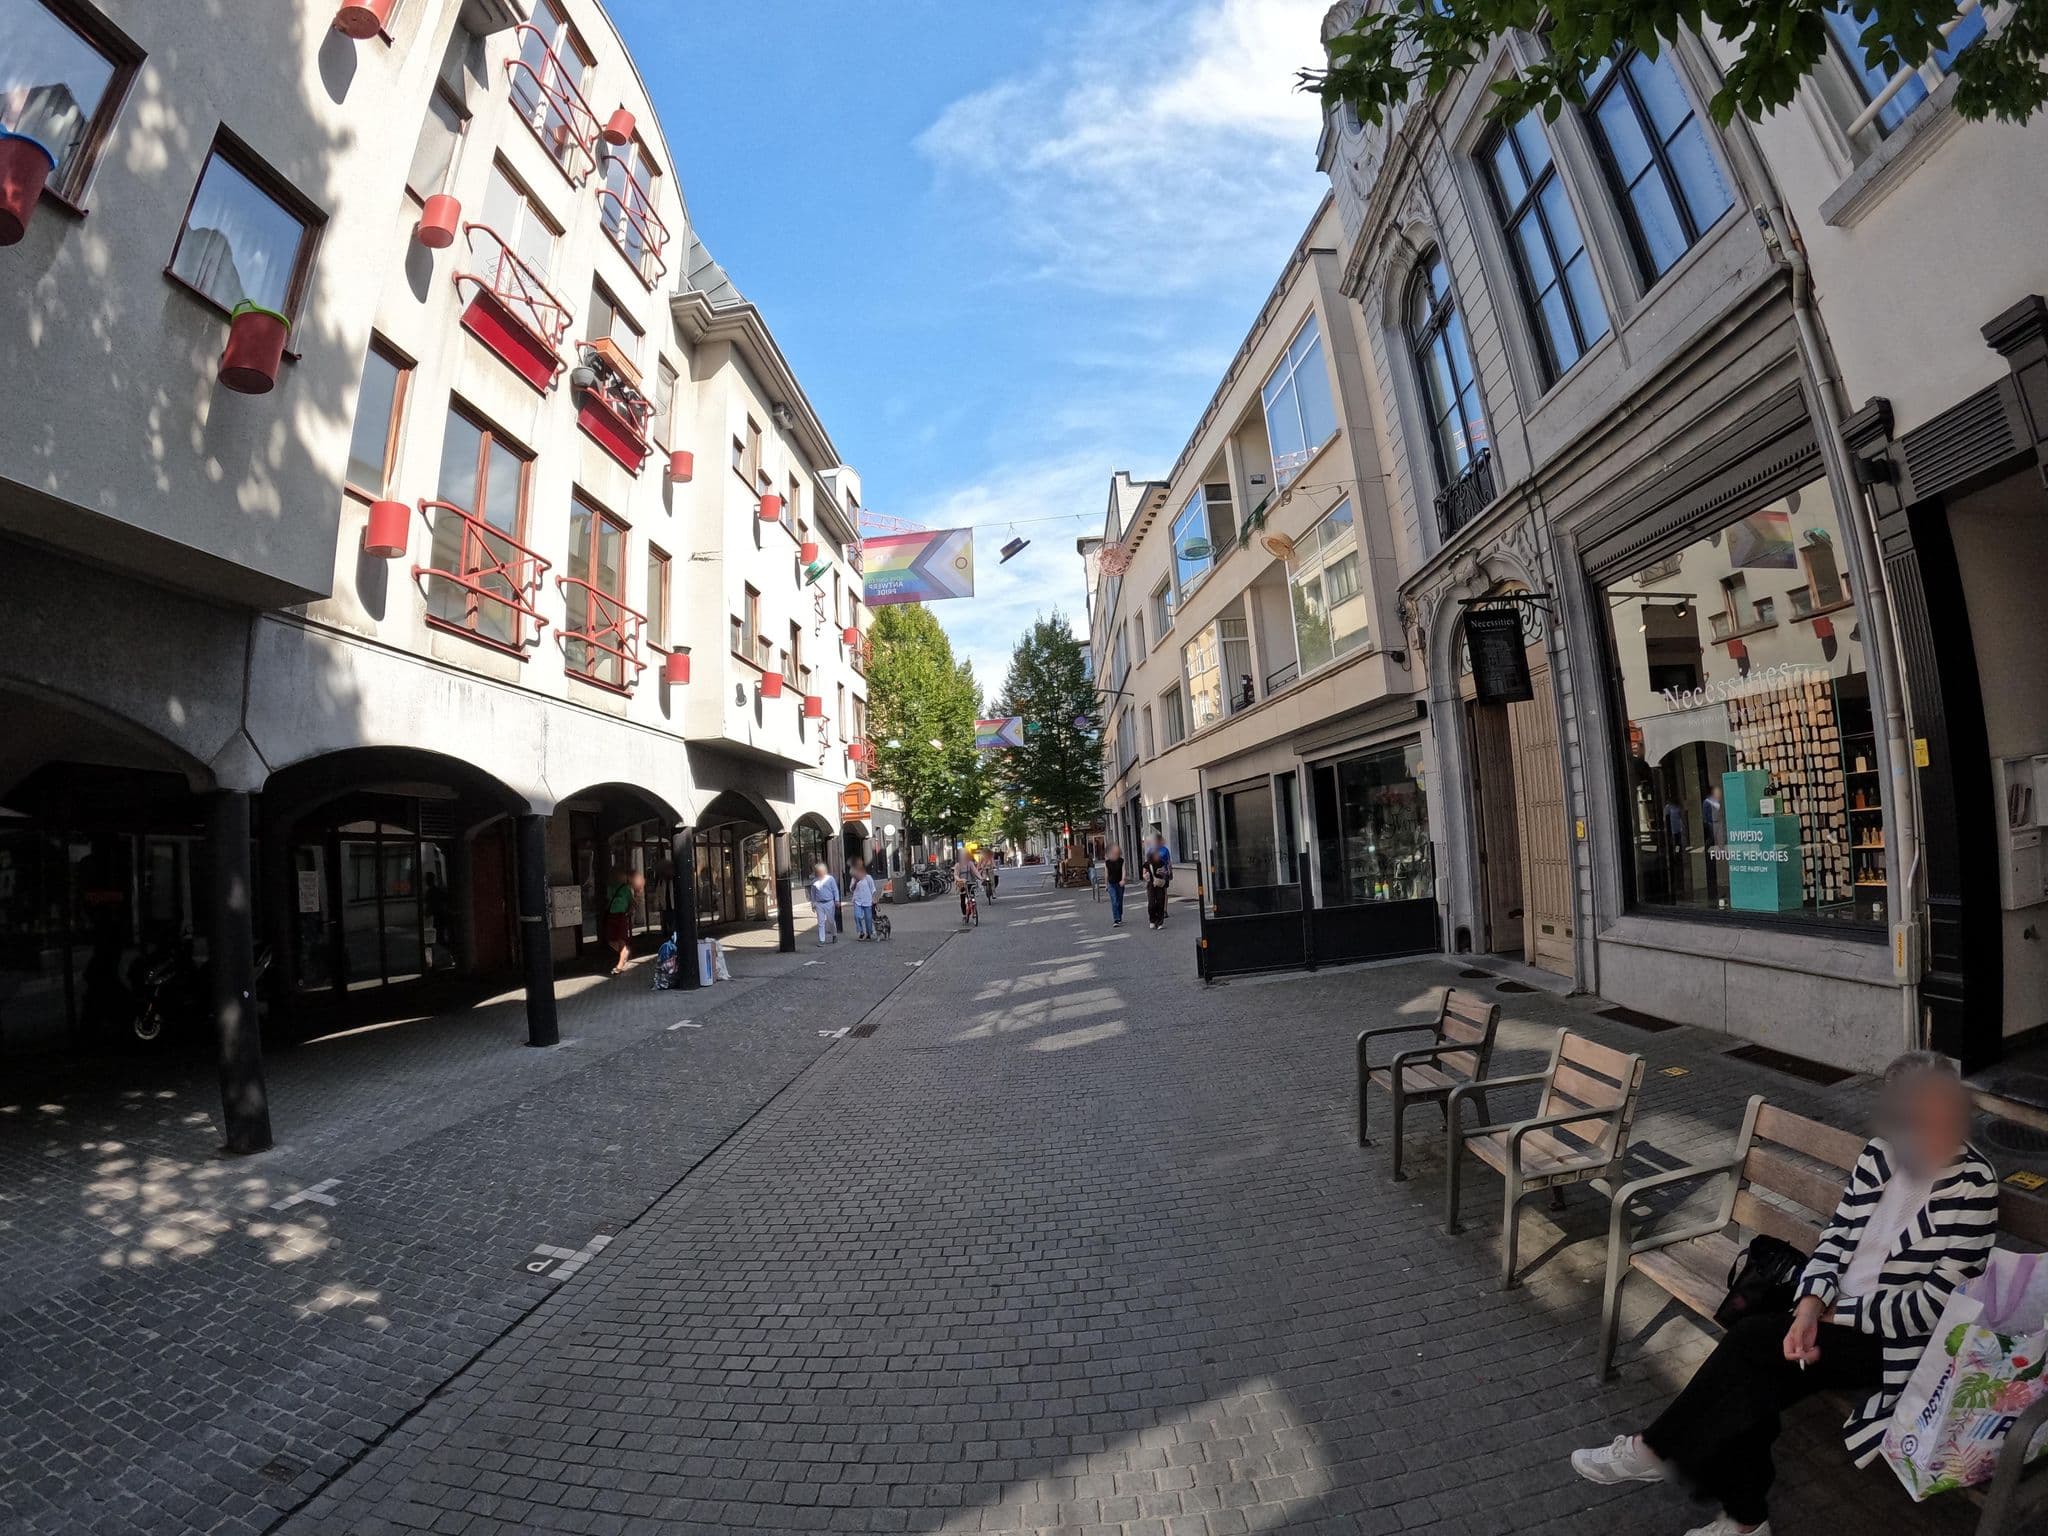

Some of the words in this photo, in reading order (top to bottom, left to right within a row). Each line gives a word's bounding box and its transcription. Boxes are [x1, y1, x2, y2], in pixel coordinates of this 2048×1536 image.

[1470, 617, 1515, 629] Necessities
[1663, 662, 1803, 713] Necessities
[1729, 830, 1764, 842] BYREDO
[1709, 850, 1742, 861] FUTURE
[1743, 850, 1789, 862] MEMORIES
[1747, 865, 1769, 873] PARFUM
